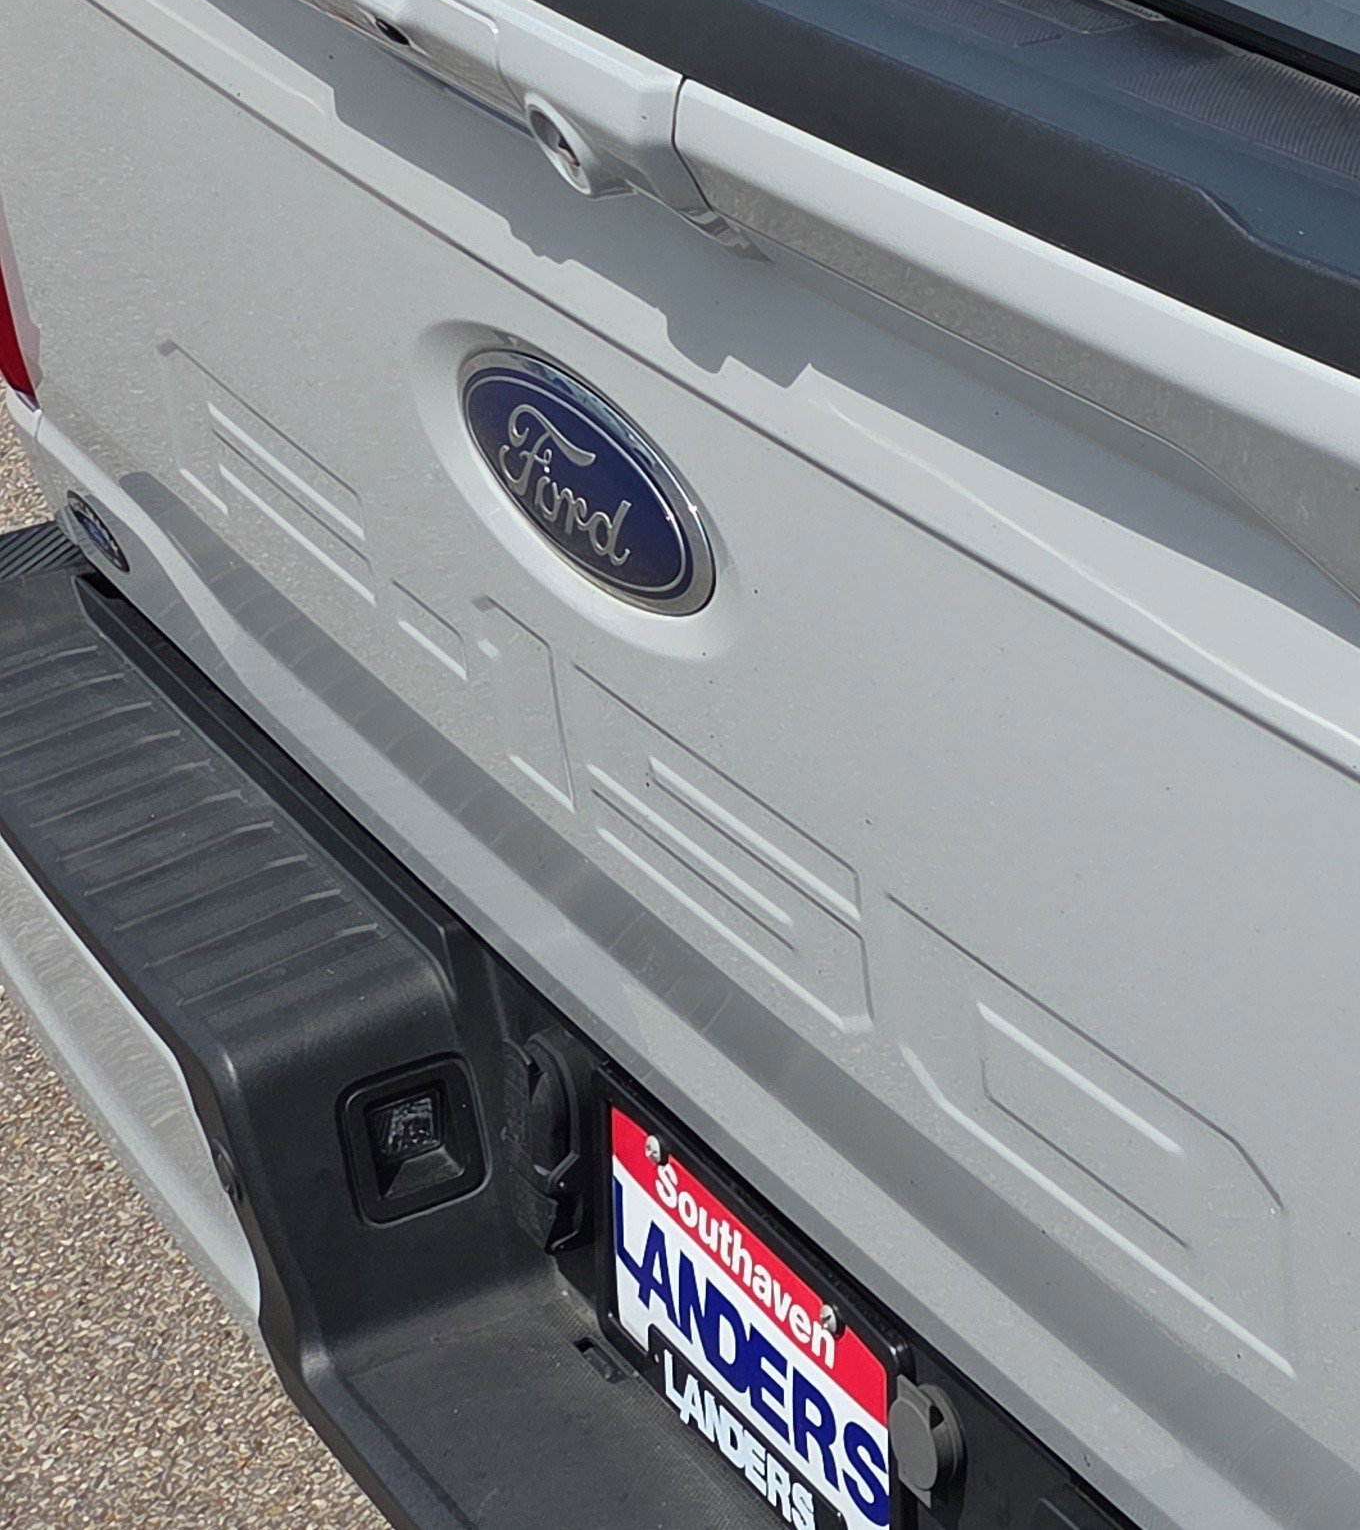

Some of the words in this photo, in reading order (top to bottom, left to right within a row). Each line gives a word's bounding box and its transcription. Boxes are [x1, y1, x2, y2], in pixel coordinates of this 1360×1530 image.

[499, 403, 632, 566] Ford
[612, 1174, 890, 1528] LANDERS
[655, 1162, 836, 1369] Southaven
[664, 1348, 816, 1530] LANDERS
